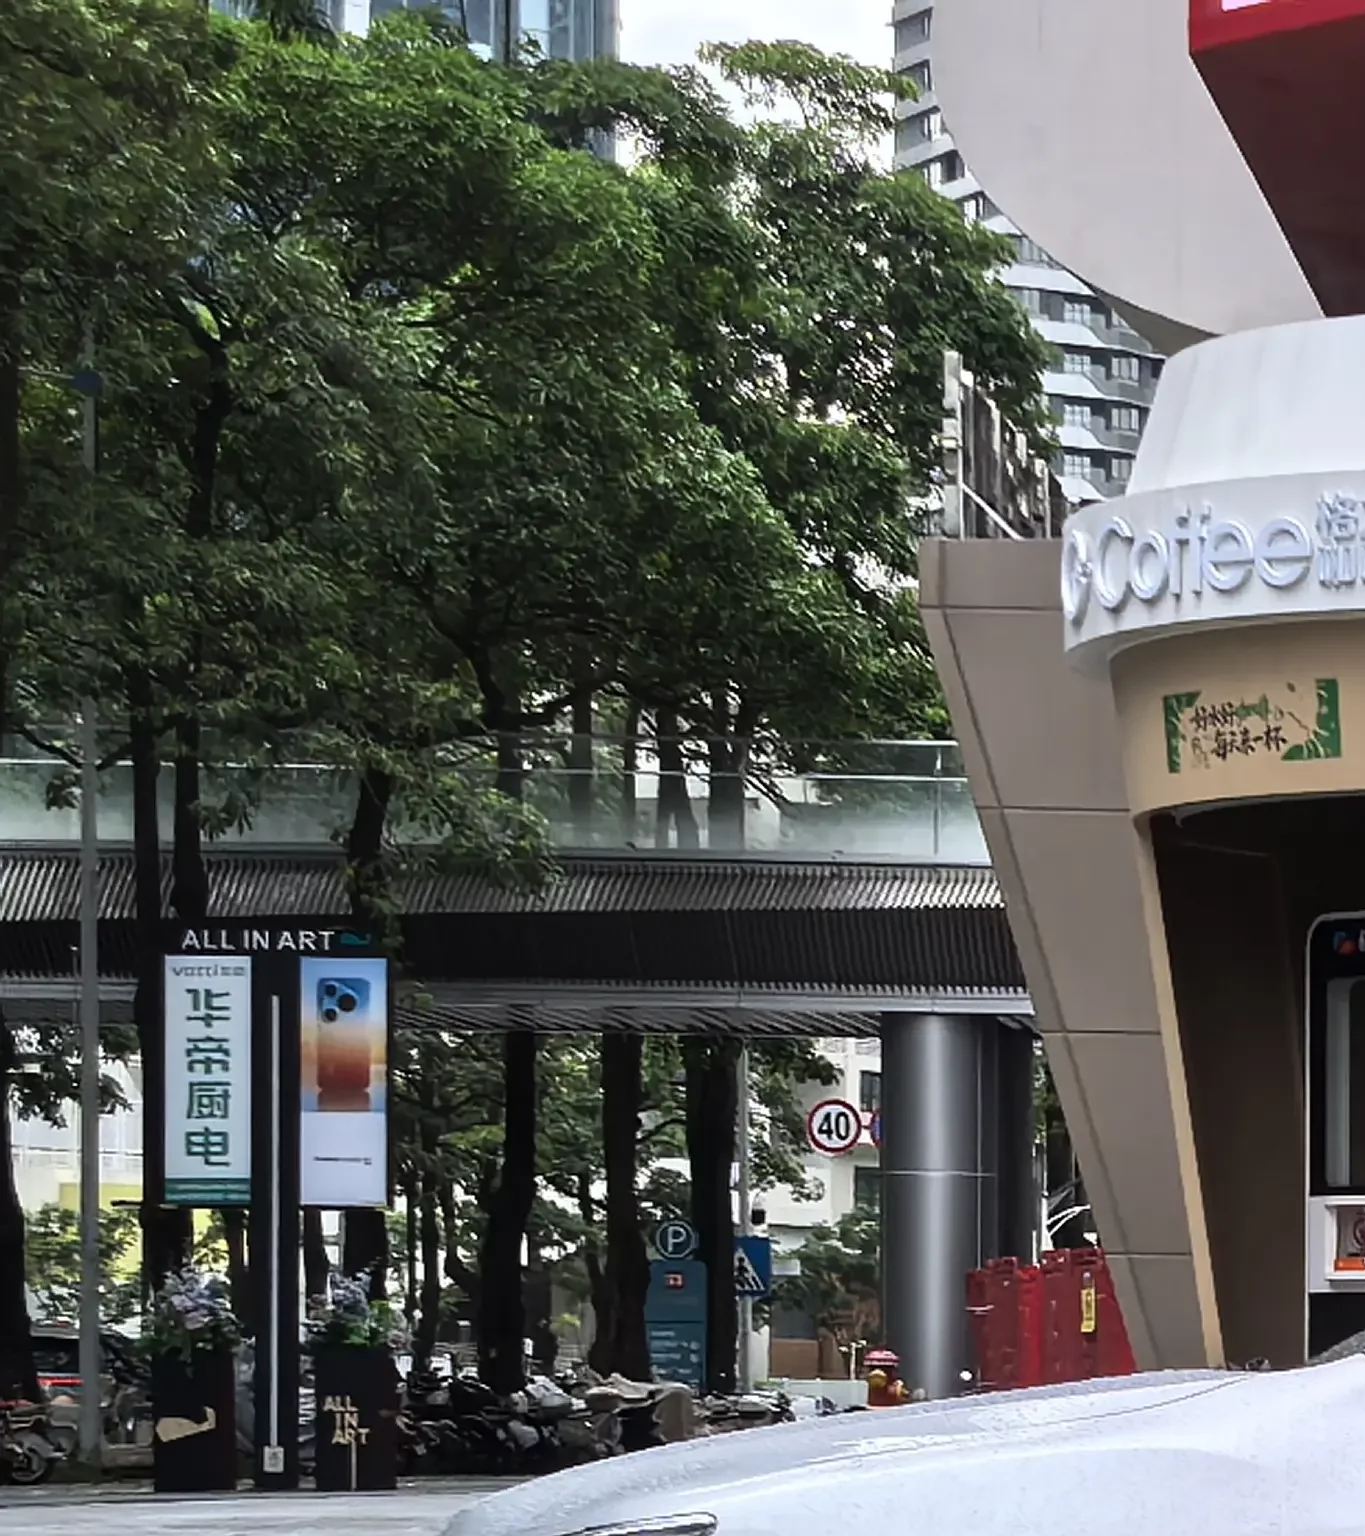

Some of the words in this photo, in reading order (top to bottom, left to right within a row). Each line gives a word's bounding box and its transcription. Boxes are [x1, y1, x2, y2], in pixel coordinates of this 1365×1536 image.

[181, 929, 235, 950] ALL
[244, 930, 269, 950] IN
[277, 930, 335, 950] ART
[185, 988, 231, 1167] 华帝厨电
[817, 1111, 850, 1141] 40
[667, 1226, 687, 1253] P
[323, 1395, 359, 1412] ALL
[334, 1412, 359, 1429] IN
[332, 1427, 370, 1445] ART
